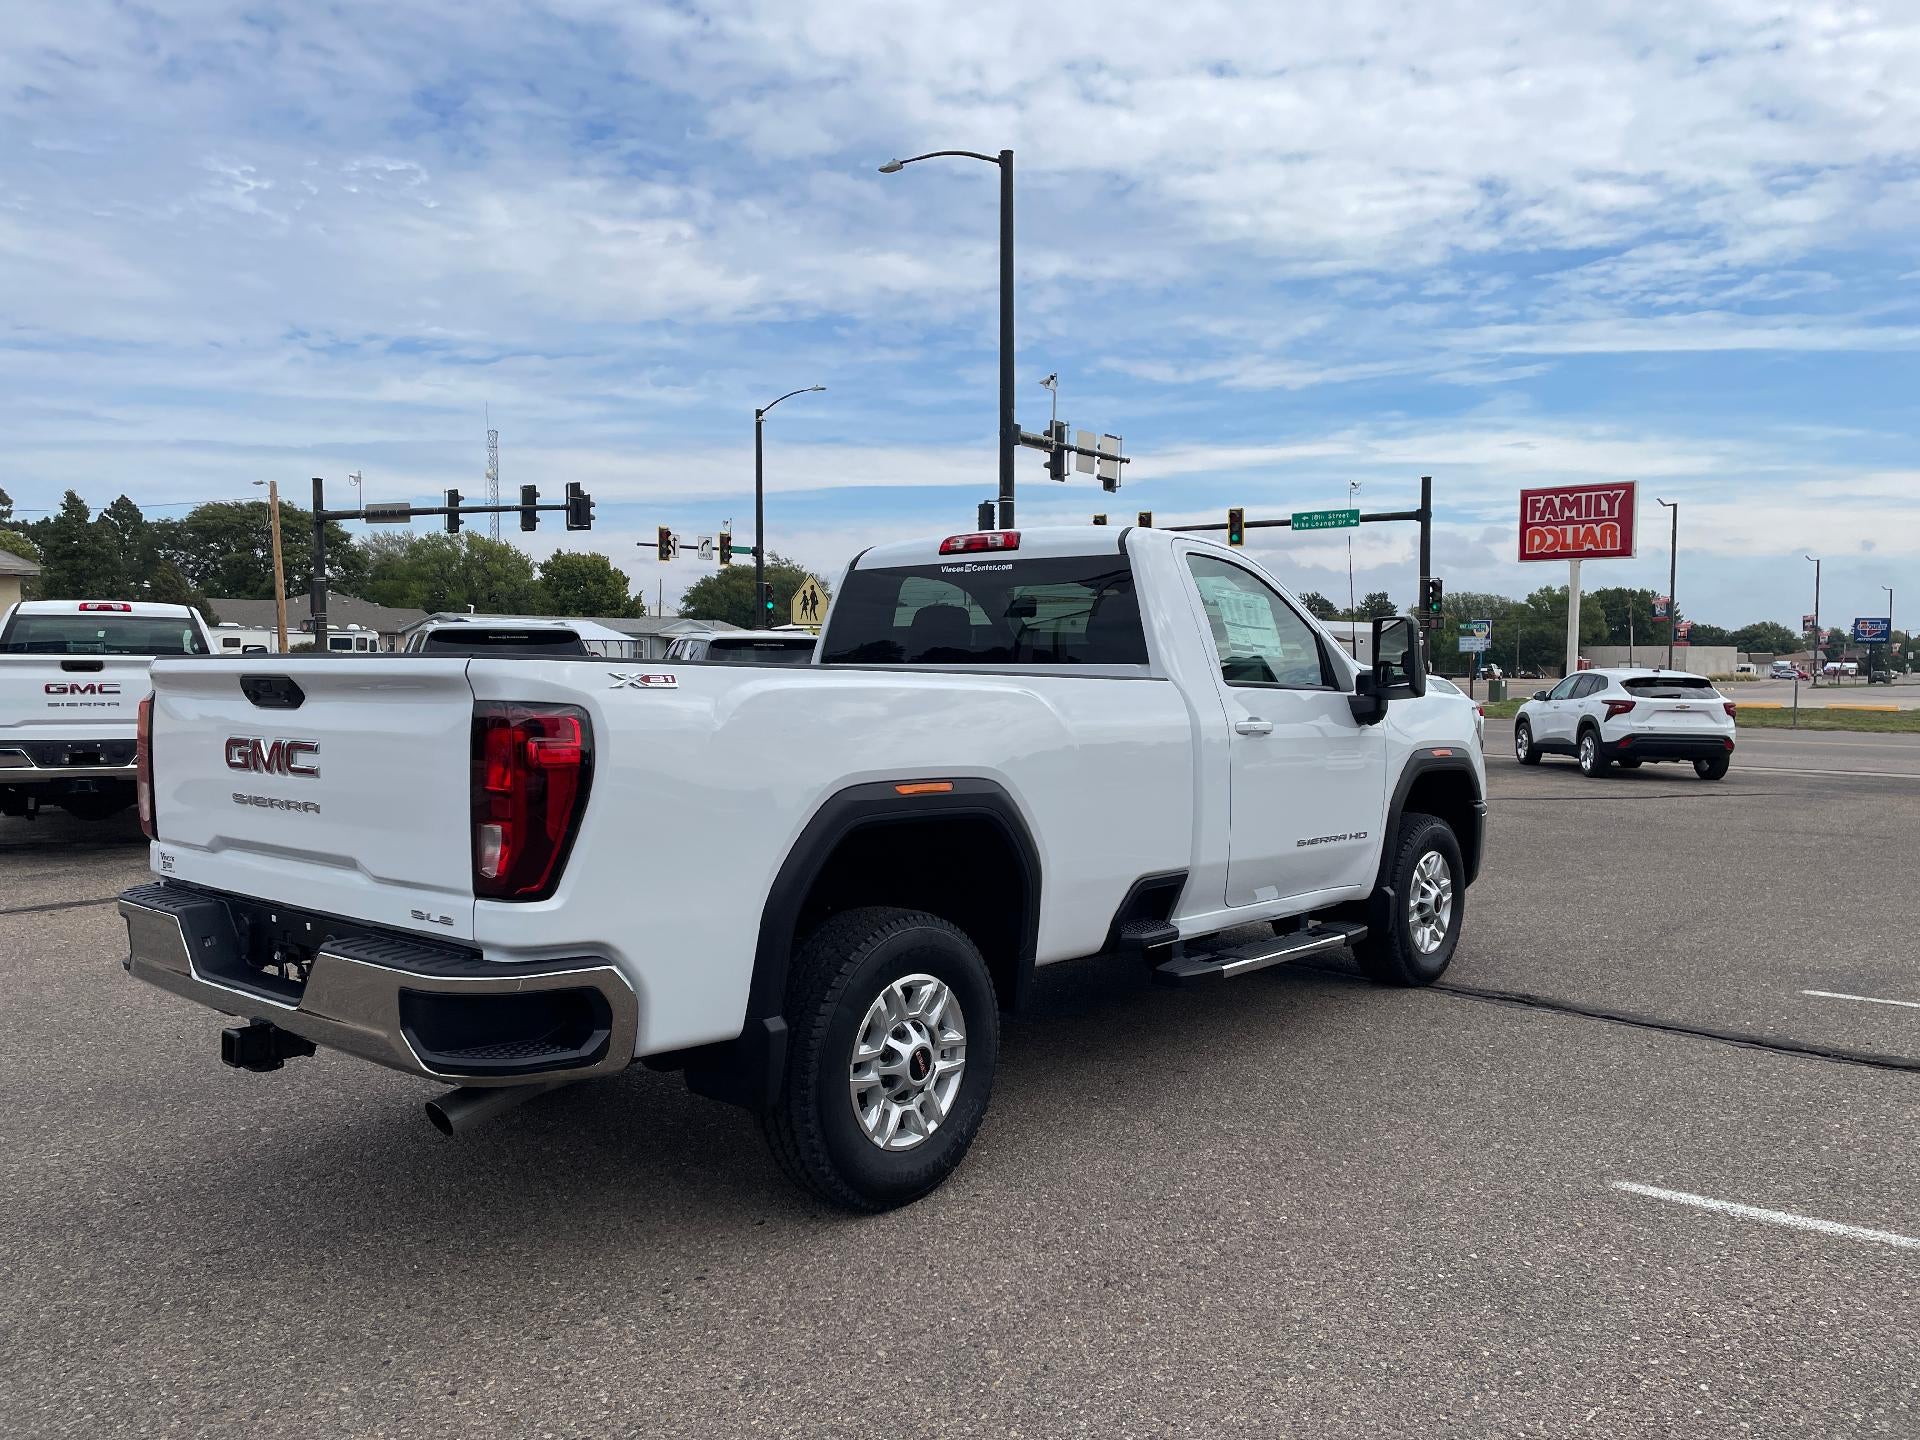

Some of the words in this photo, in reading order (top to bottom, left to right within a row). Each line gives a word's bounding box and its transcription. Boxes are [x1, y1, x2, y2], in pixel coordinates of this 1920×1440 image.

[1526, 489, 1626, 523] FAMILY
[1526, 522, 1620, 554] DOLLAR
[44, 683, 121, 695] GMC
[225, 735, 320, 779] GMC
[232, 792, 321, 815] SIERRA
[1296, 833, 1347, 848] SIERRA
[1349, 831, 1368, 841] HD
[411, 909, 455, 926] SLE
